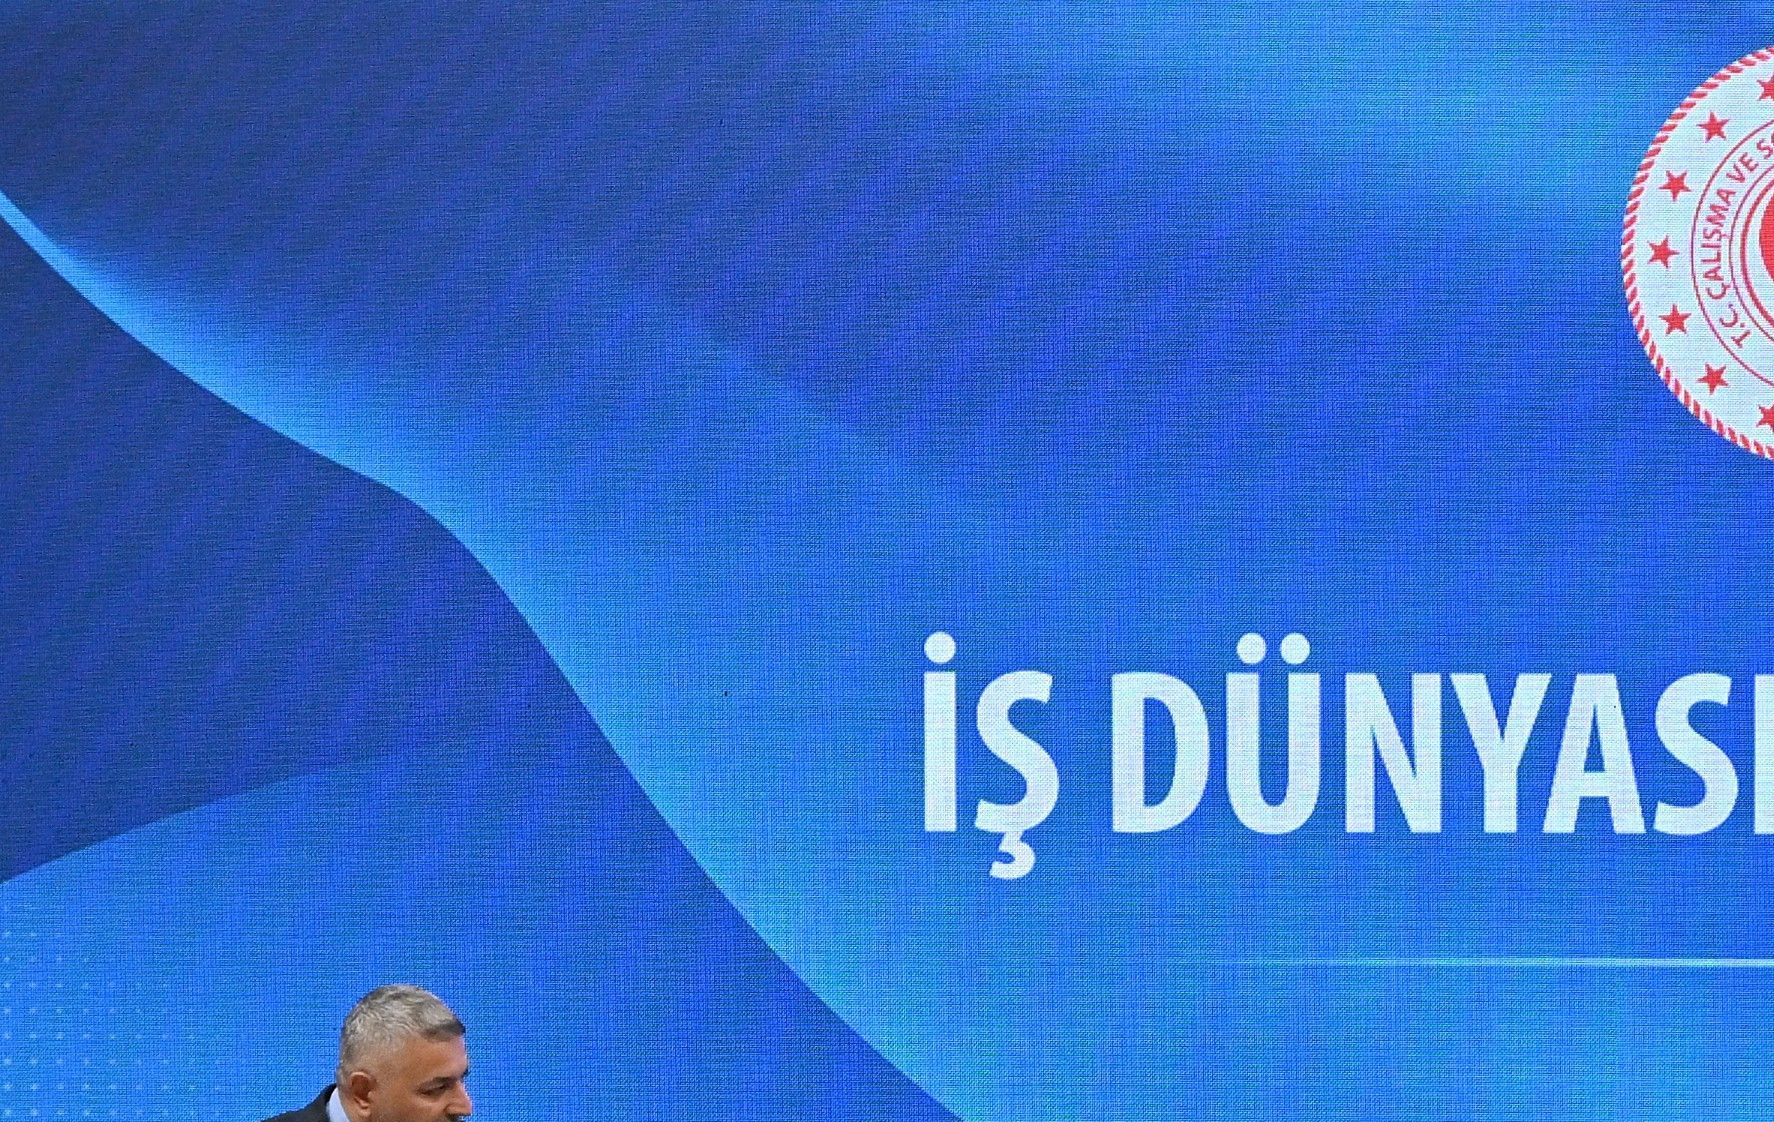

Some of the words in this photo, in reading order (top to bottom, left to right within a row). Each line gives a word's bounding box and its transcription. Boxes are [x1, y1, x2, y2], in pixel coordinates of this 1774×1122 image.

[1726, 153, 1759, 183] VE
[1701, 186, 1735, 301] ÇALIŞMA
[1719, 303, 1752, 349] T.C.
[923, 631, 1060, 881] İŞ
